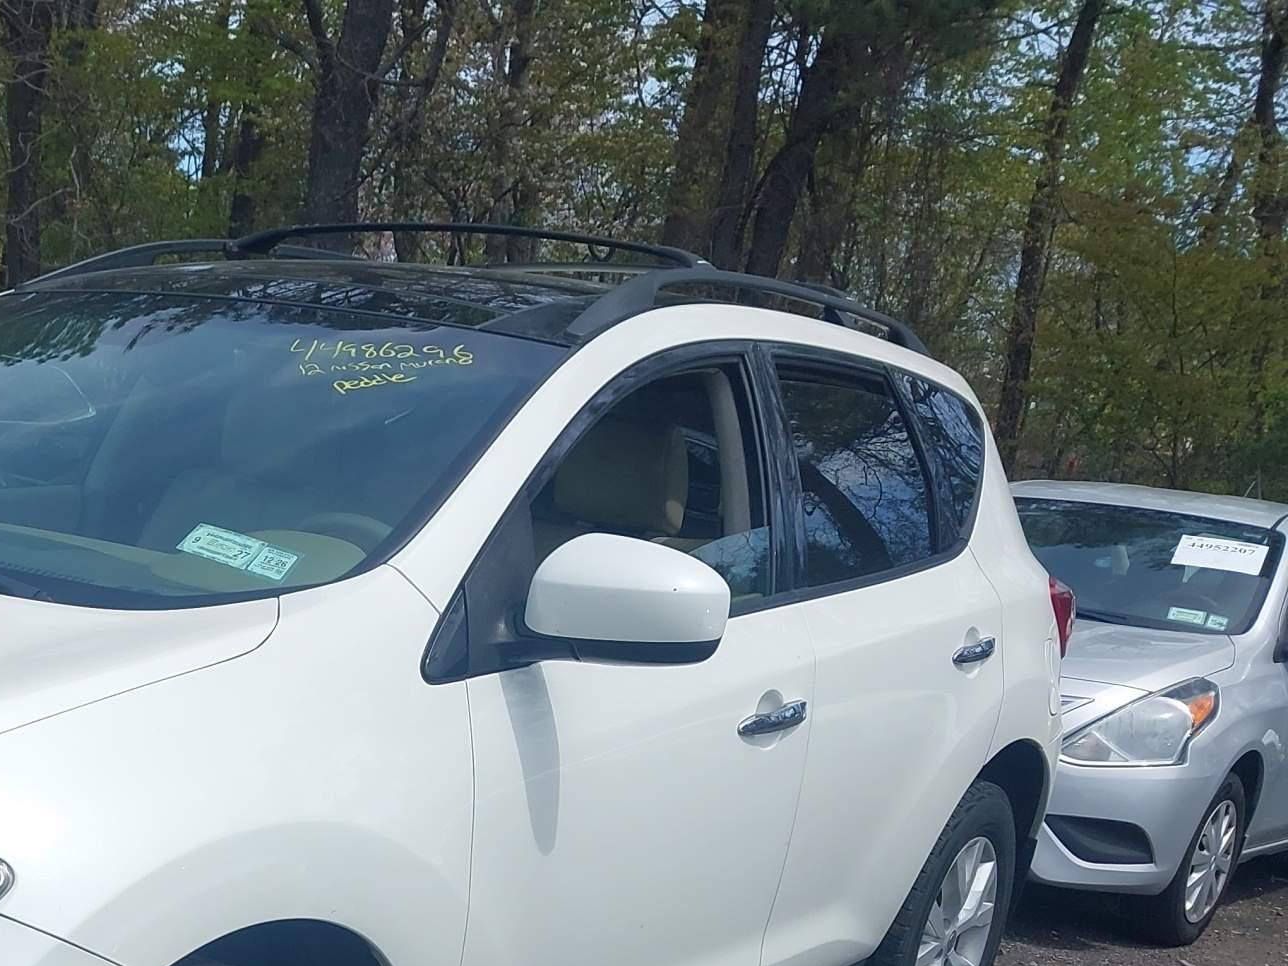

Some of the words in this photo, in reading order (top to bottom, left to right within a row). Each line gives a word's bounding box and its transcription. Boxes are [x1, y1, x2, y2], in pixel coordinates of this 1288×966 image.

[289, 338, 474, 361] 44986296
[298, 363, 325, 376] 12
[232, 549, 251, 560] 27
[1188, 542, 1256, 555] 44952207
